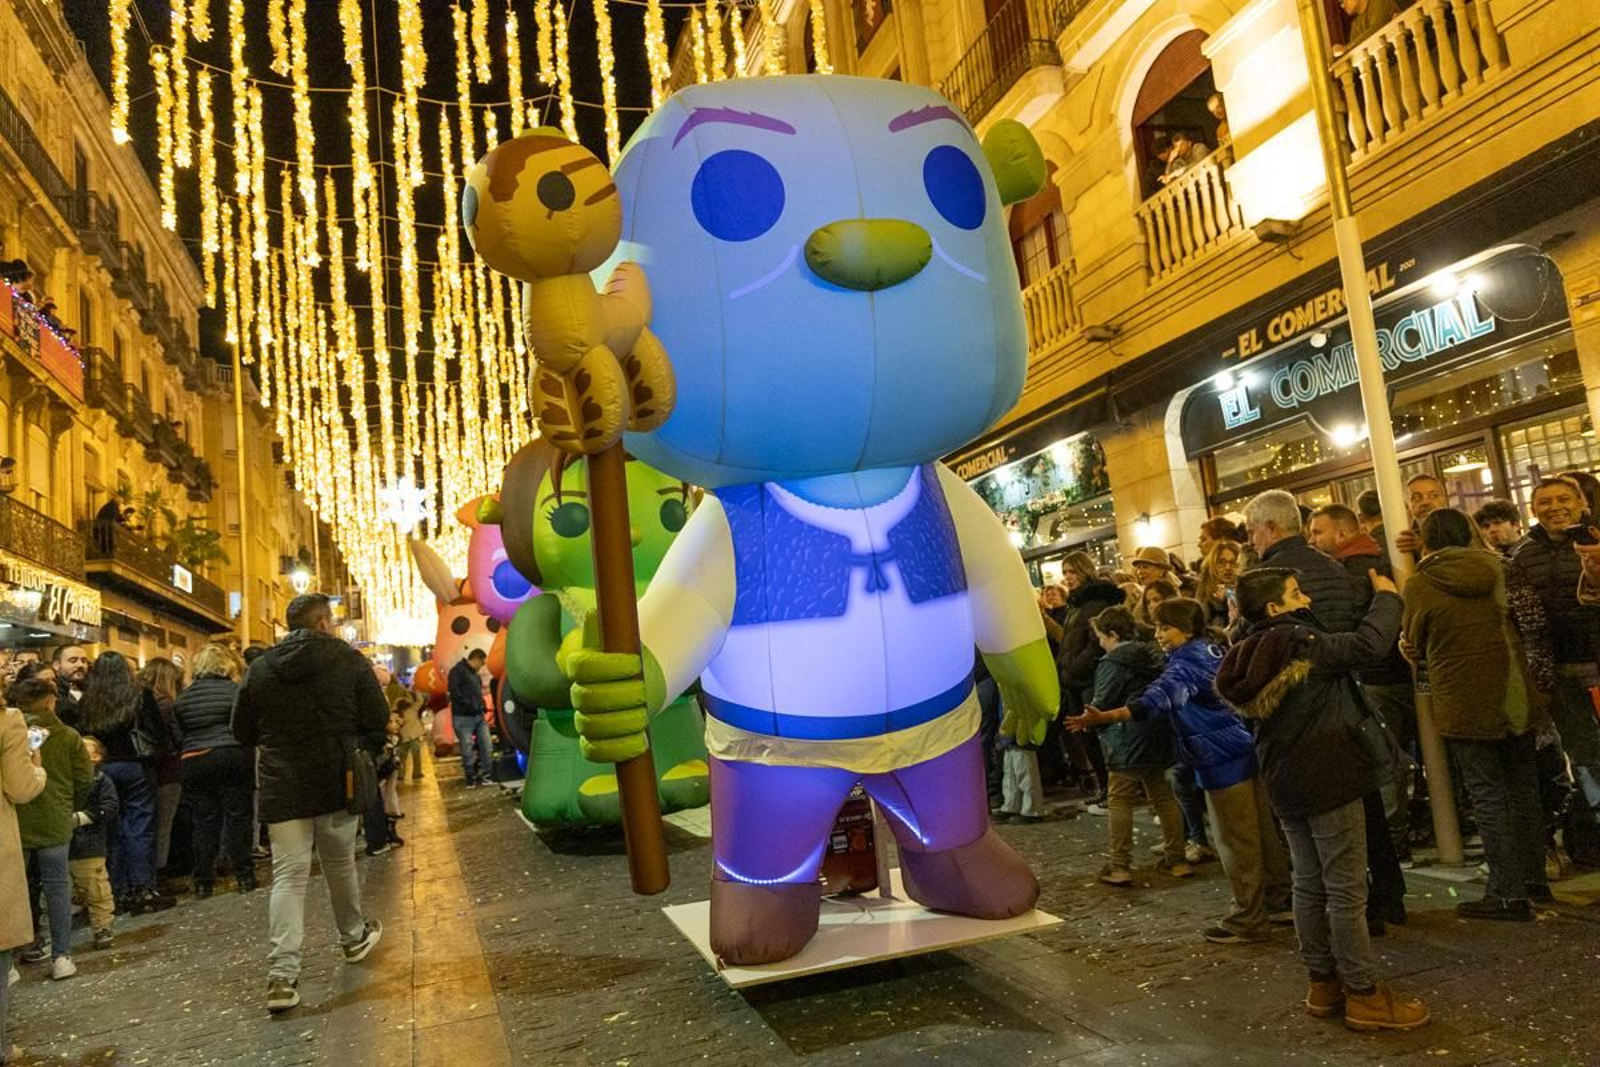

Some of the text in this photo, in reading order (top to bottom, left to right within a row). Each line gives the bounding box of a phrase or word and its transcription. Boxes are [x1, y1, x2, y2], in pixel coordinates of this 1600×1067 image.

[1238, 328, 1263, 358] EL
[1267, 261, 1396, 342] COMERAL
[1218, 383, 1261, 429] EL
[48, 583, 62, 621] El
